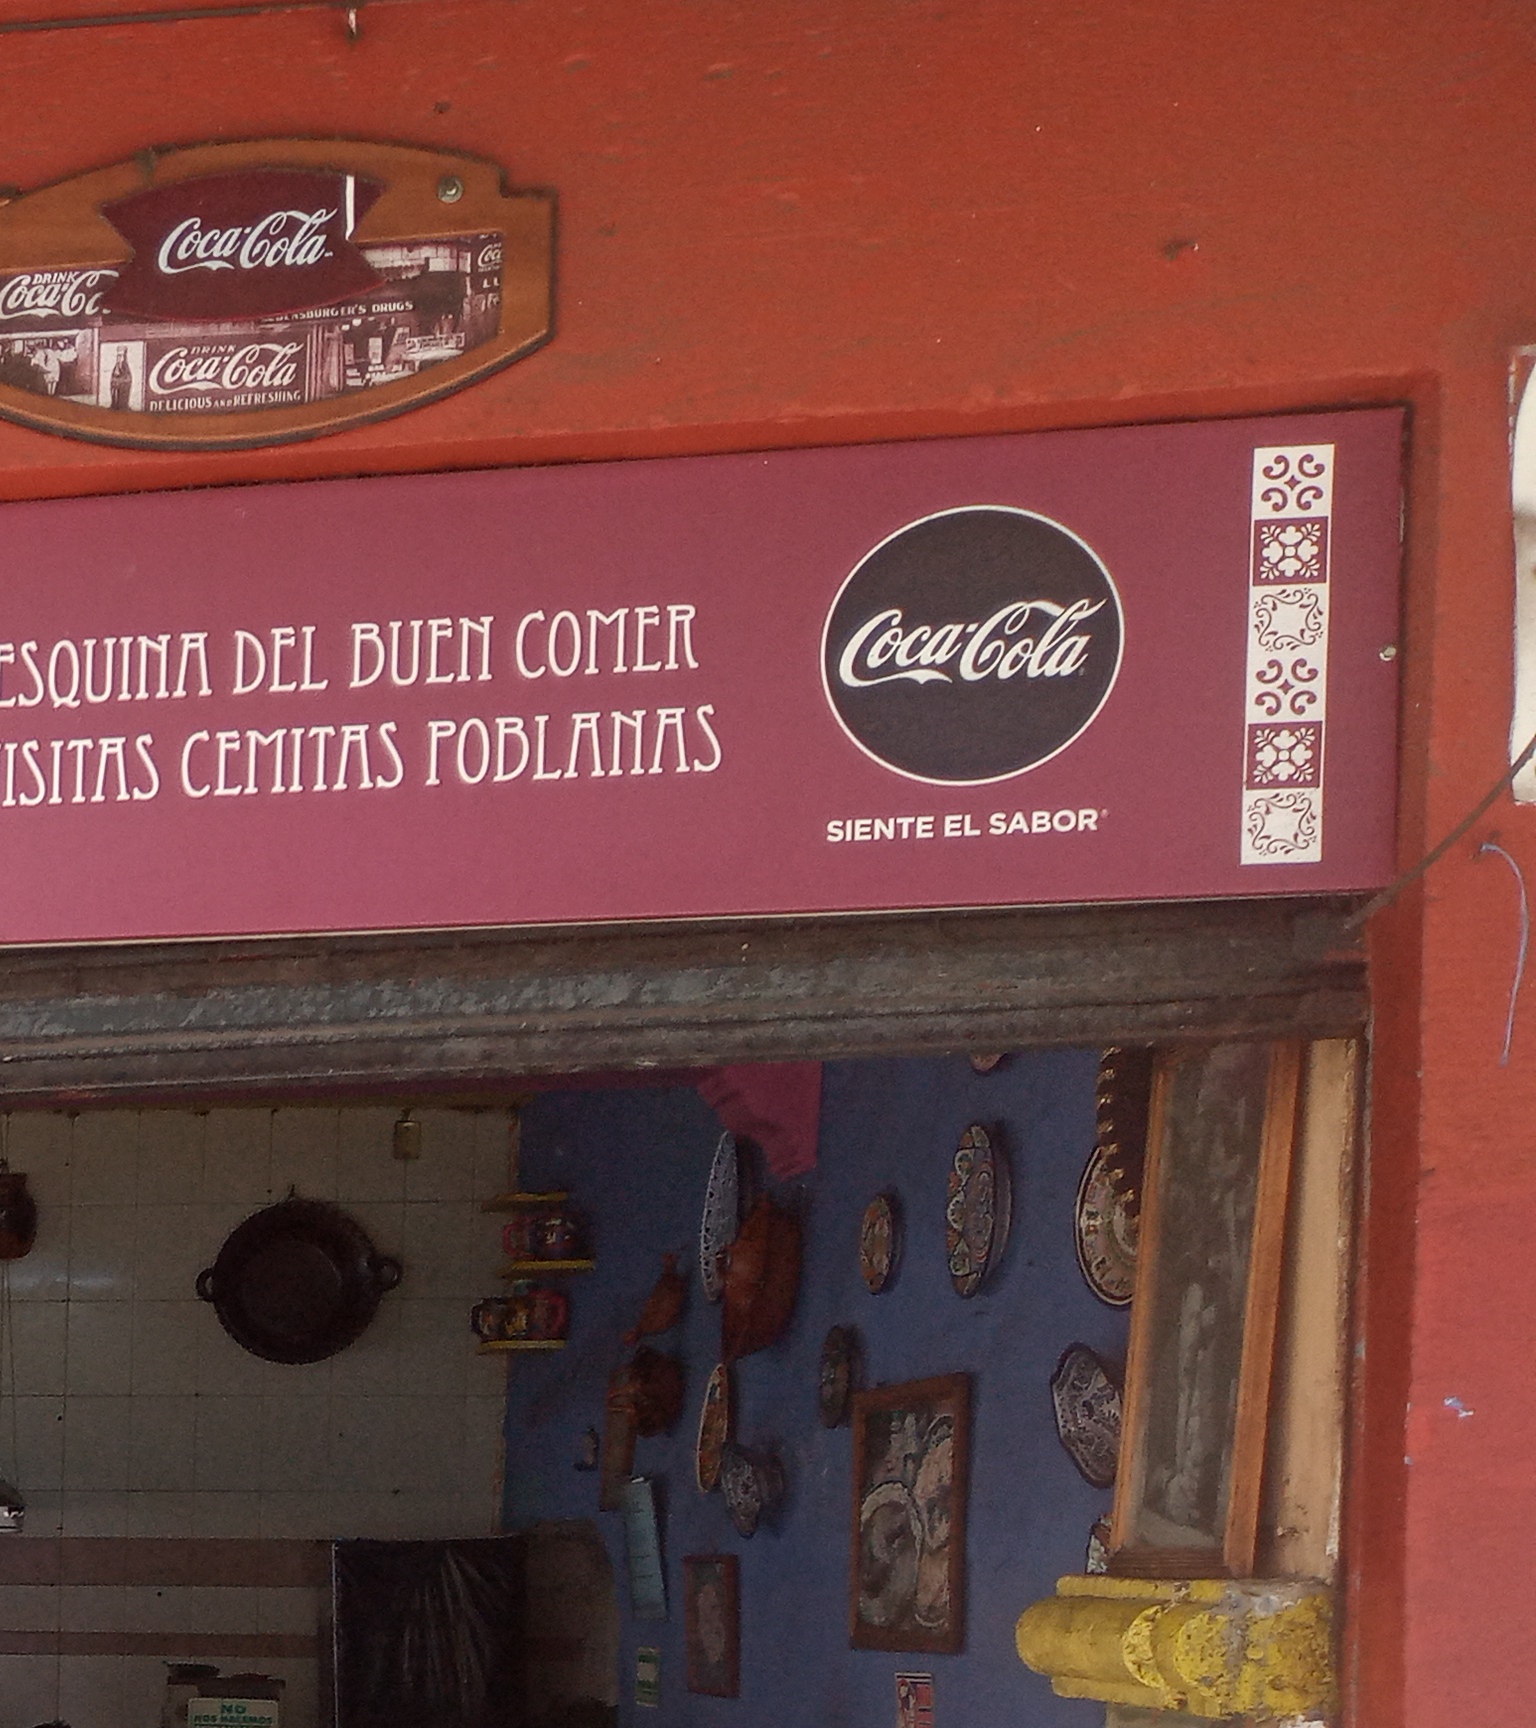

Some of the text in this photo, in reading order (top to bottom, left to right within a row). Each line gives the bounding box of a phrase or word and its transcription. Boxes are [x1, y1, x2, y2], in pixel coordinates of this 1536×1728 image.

[158, 207, 337, 274] Coca-Cola
[32, 271, 80, 285] DRINK
[372, 301, 413, 313] DRUGS
[191, 344, 237, 354] DRINK
[149, 342, 304, 395] Coca-Cola
[150, 396, 212, 411] DELICIOUS
[234, 390, 302, 407] REFRESHING
[233, 625, 328, 695] DEL
[349, 615, 495, 688] BUEN
[515, 604, 699, 680] COMER
[839, 597, 1108, 688] Coca-Cola
[180, 720, 405, 798] CEMITAS
[425, 704, 723, 787] POBLANAS
[826, 809, 1098, 843] SIENTE EL SABOR
[220, 1704, 247, 1714] NO
